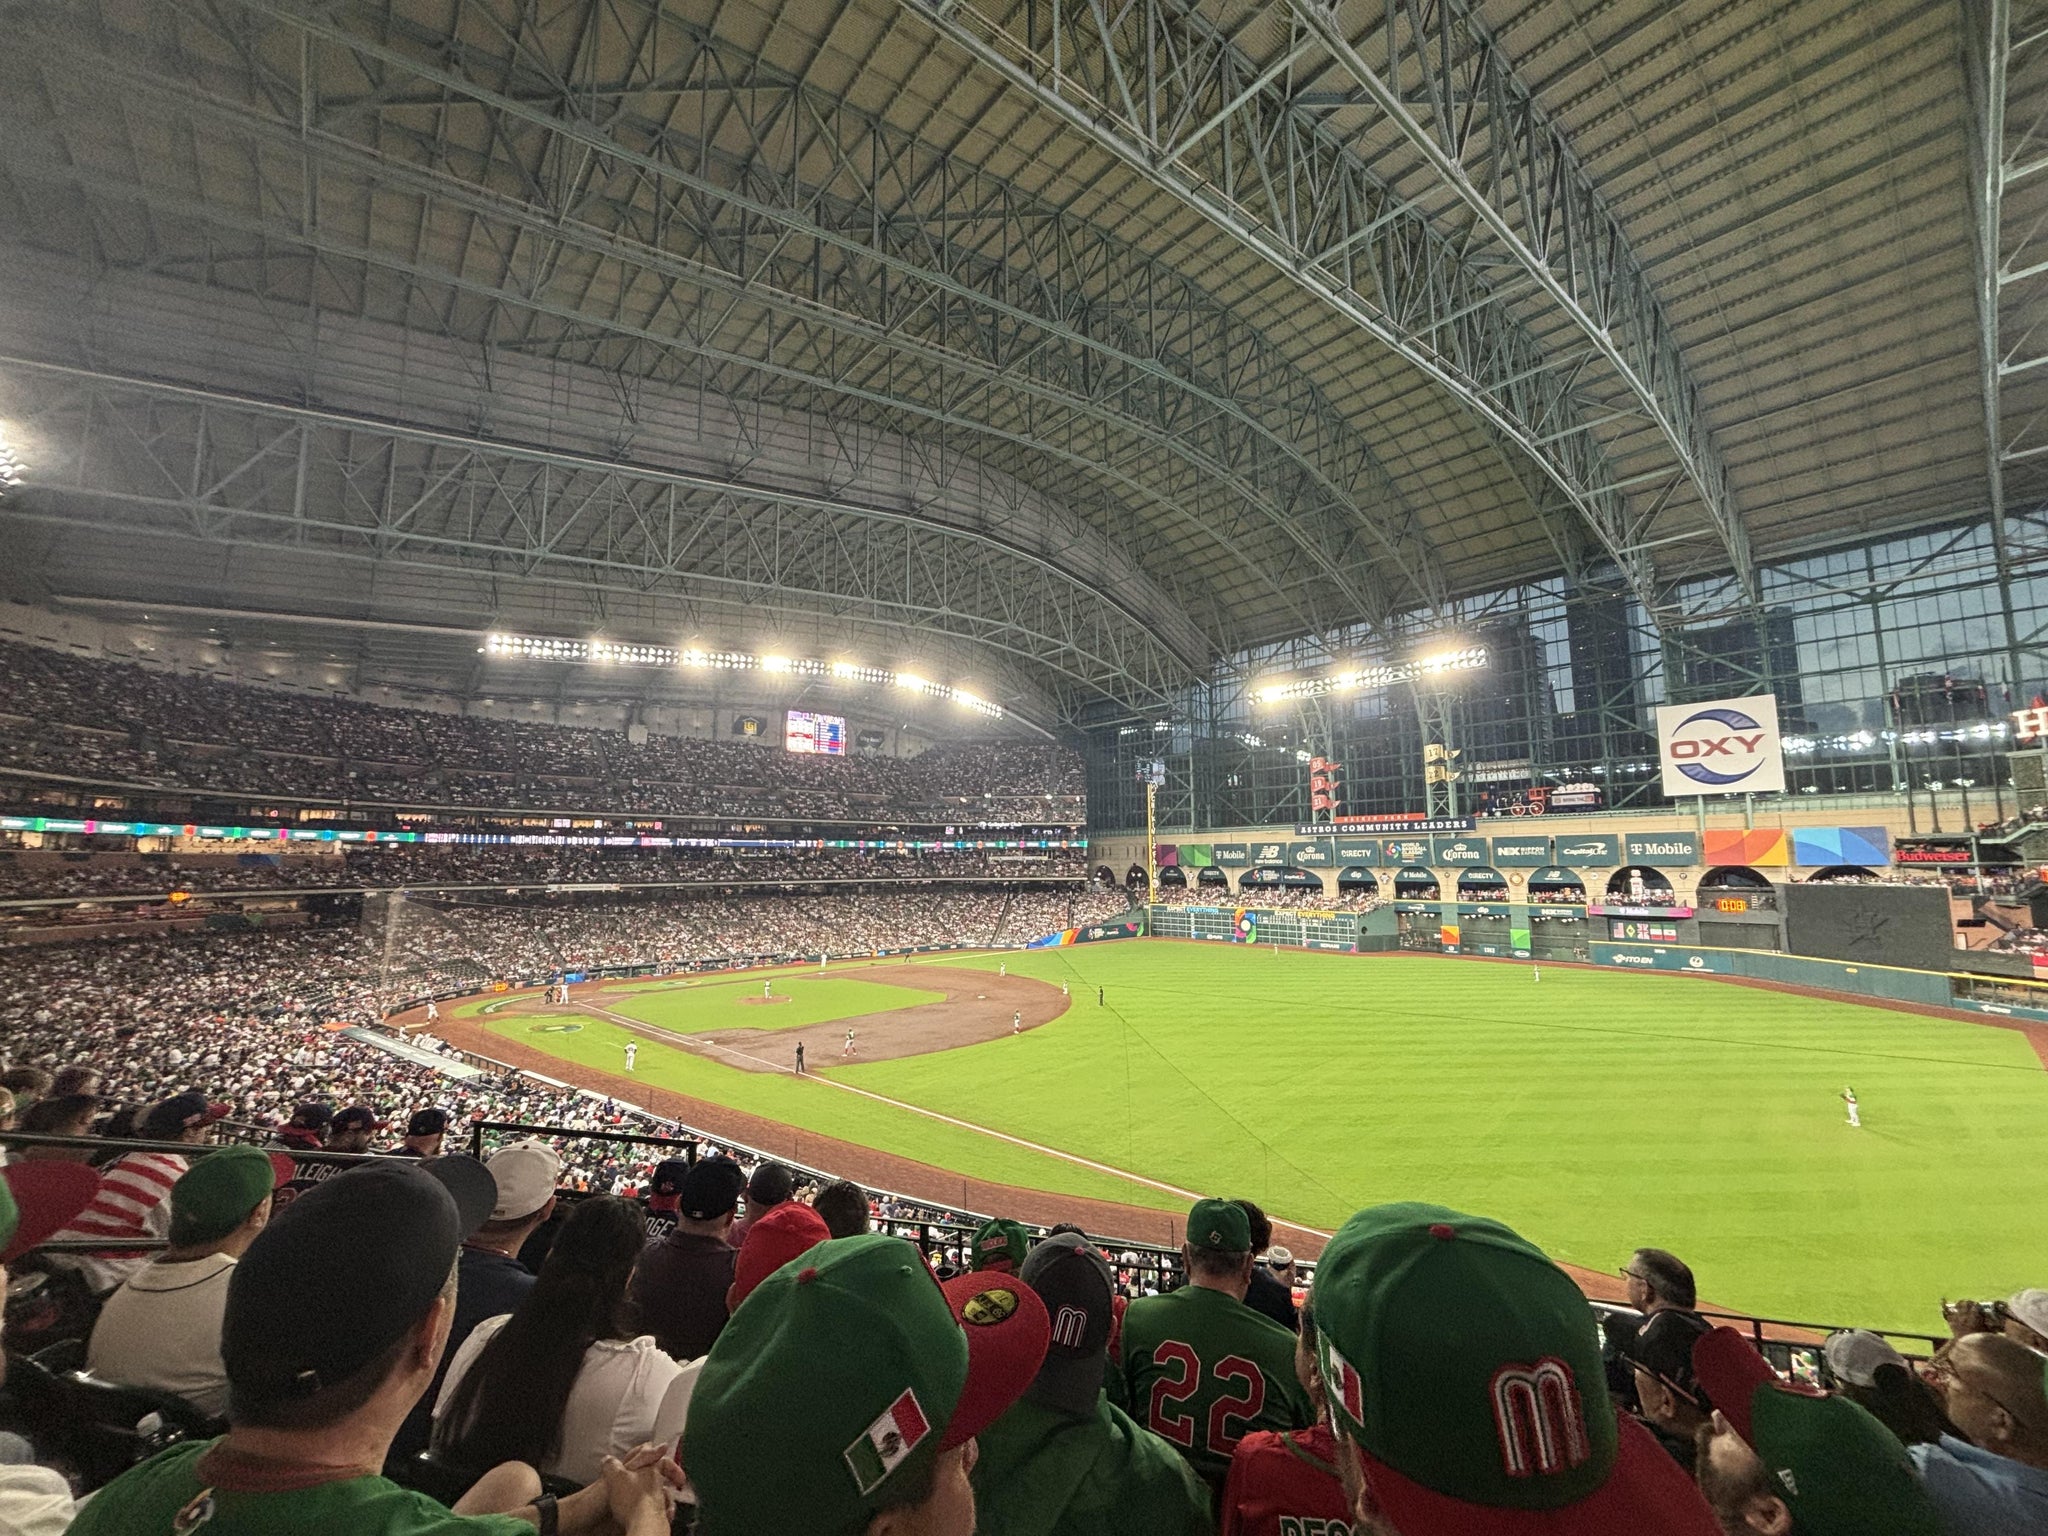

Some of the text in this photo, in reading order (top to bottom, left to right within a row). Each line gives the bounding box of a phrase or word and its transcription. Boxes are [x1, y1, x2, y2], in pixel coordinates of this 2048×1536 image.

[1670, 733, 1766, 759] OXY
[1428, 748, 1439, 757] 17
[1301, 821, 1468, 834] ASTROS COMMUNITY LEADERS
[1223, 850, 1245, 859] Mobile
[1341, 850, 1371, 858] DIRECTV
[1442, 848, 1479, 862] Corona
[1645, 843, 1692, 855] Mobile
[1296, 853, 1325, 862] Corona
[1896, 850, 1970, 862] Budweiser
[1149, 1340, 1265, 1458] 22
